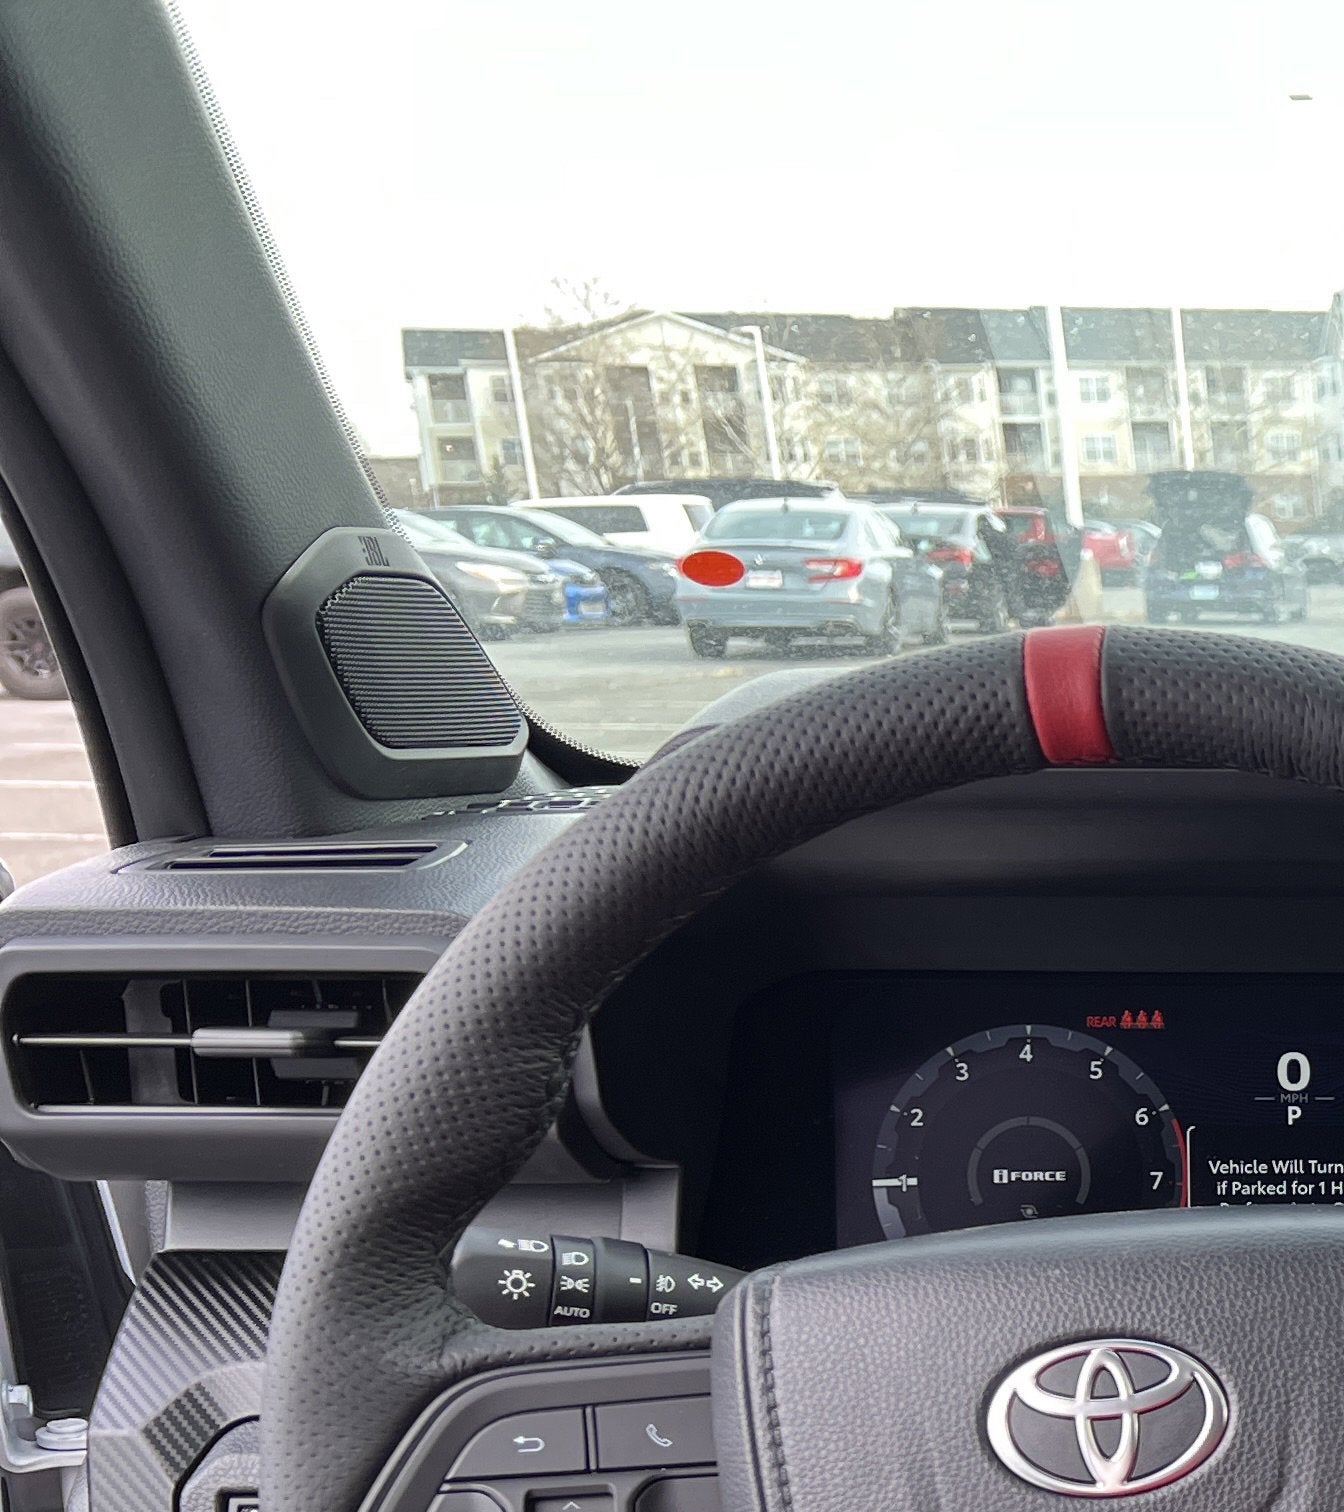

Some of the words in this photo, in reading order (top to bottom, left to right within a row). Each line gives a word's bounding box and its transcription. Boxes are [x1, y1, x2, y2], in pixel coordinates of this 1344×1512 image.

[1086, 1016, 1117, 1028] REAR
[1019, 1045, 1033, 1062] 4
[955, 1063, 970, 1081] 3
[1089, 1061, 1103, 1079] 5
[1277, 1051, 1311, 1092] 0
[1280, 1093, 1309, 1104] MPH
[911, 1109, 924, 1126] 2
[1134, 1108, 1149, 1126] 6
[1287, 1105, 1302, 1126] P
[1208, 1159, 1268, 1175] Vehicle
[1271, 1159, 1305, 1174] Will
[1308, 1160, 1344, 1175] Turn
[1149, 1171, 1164, 1190] 7
[1216, 1181, 1228, 1196] if
[1232, 1181, 1287, 1196] Parked
[1291, 1181, 1314, 1196] for
[1318, 1182, 1326, 1195] 1
[553, 1304, 591, 1319] AUTO
[650, 1302, 679, 1316] OFF
